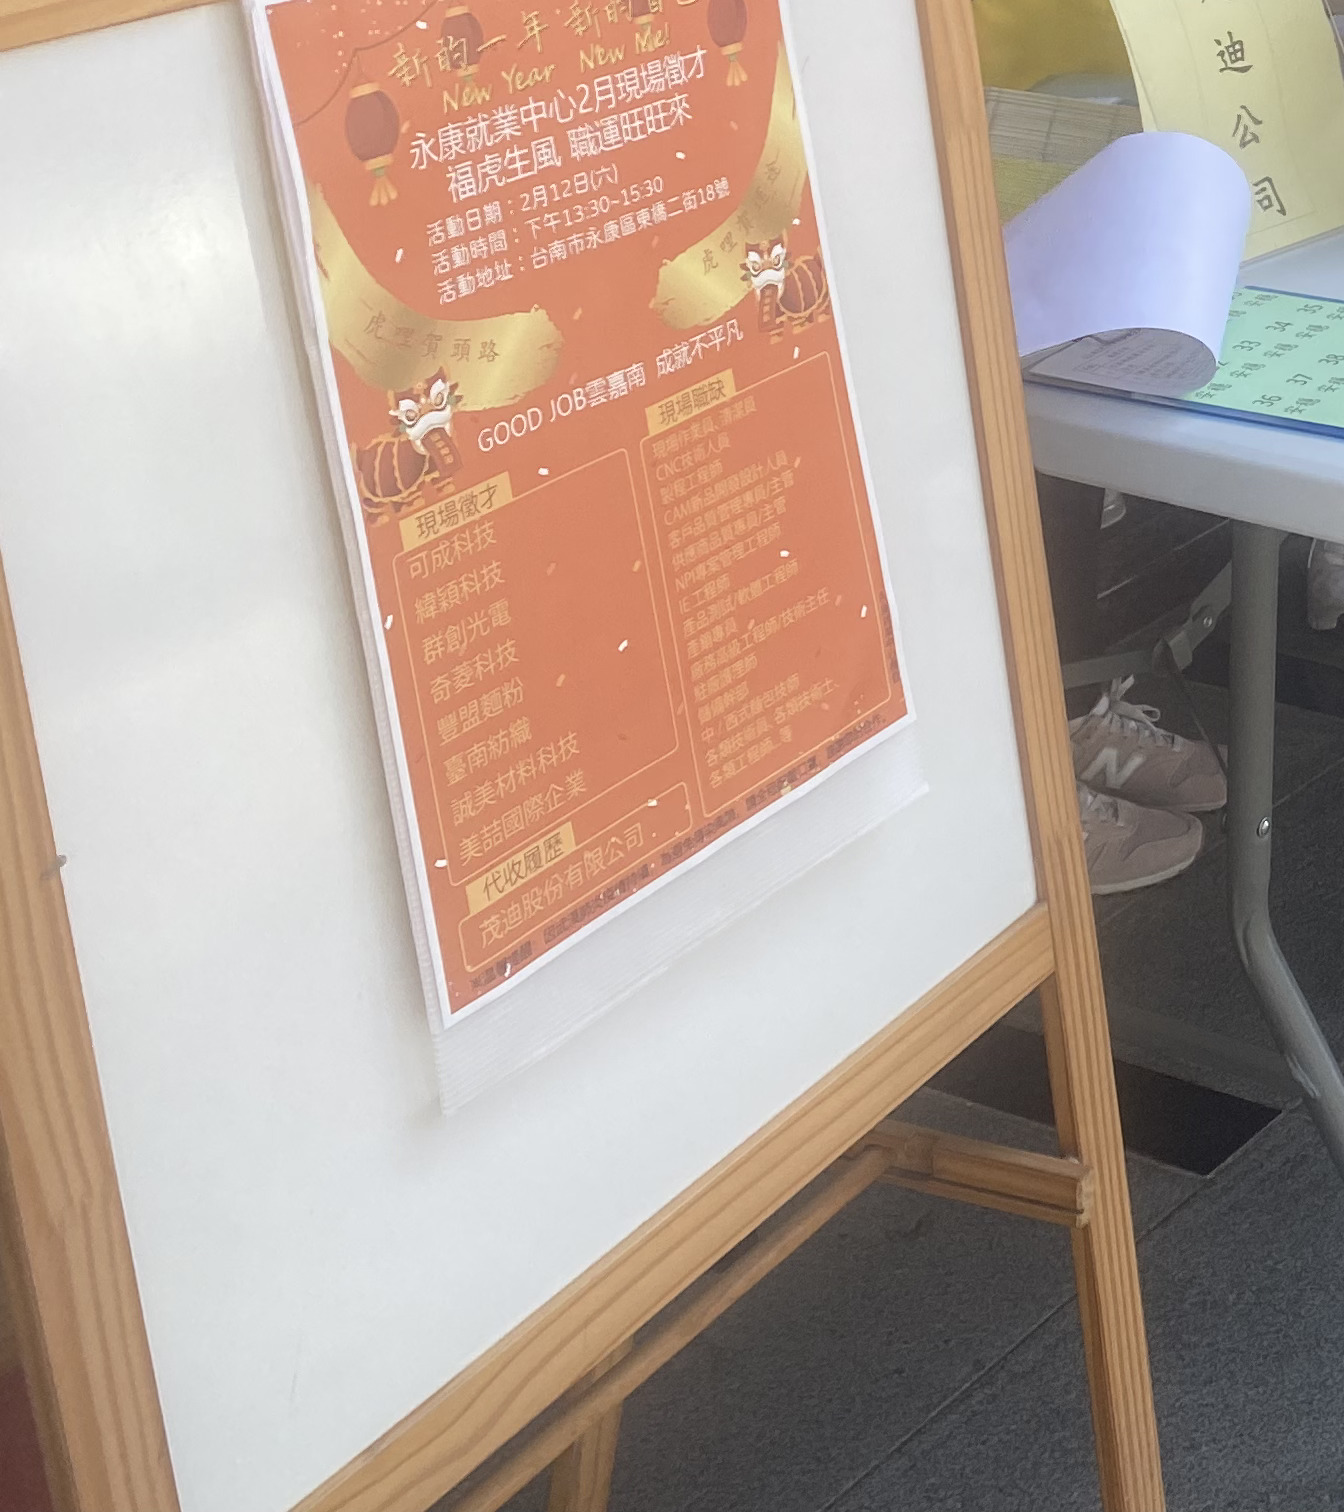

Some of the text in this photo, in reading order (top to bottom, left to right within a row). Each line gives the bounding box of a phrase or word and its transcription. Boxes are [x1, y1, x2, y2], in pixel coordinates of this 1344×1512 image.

[500, 55, 559, 98] Year
[576, 35, 627, 74] New
[631, 21, 673, 56] Me!
[404, 43, 712, 174] 永康就業中心2月現場徵才
[443, 88, 694, 206] 福虎生風 職運旺旺來
[1265, 321, 1294, 332] 34
[1296, 303, 1324, 314] 35
[1232, 340, 1261, 351] 33
[1286, 373, 1313, 386] 37
[475, 404, 545, 456] GOOD
[653, 315, 745, 379] 成就不平凡
[657, 375, 727, 429] 現場職缺
[1252, 394, 1282, 407] 36
[414, 478, 501, 542] 現場徵才
[405, 515, 498, 586] 可成科技
[420, 595, 512, 667] 群創光電
[427, 634, 520, 708] 奇菱科技
[448, 727, 581, 829] 誠美材料科技
[477, 819, 645, 950] 茂迪股份有限公司
[481, 829, 565, 904] 代收履歷
